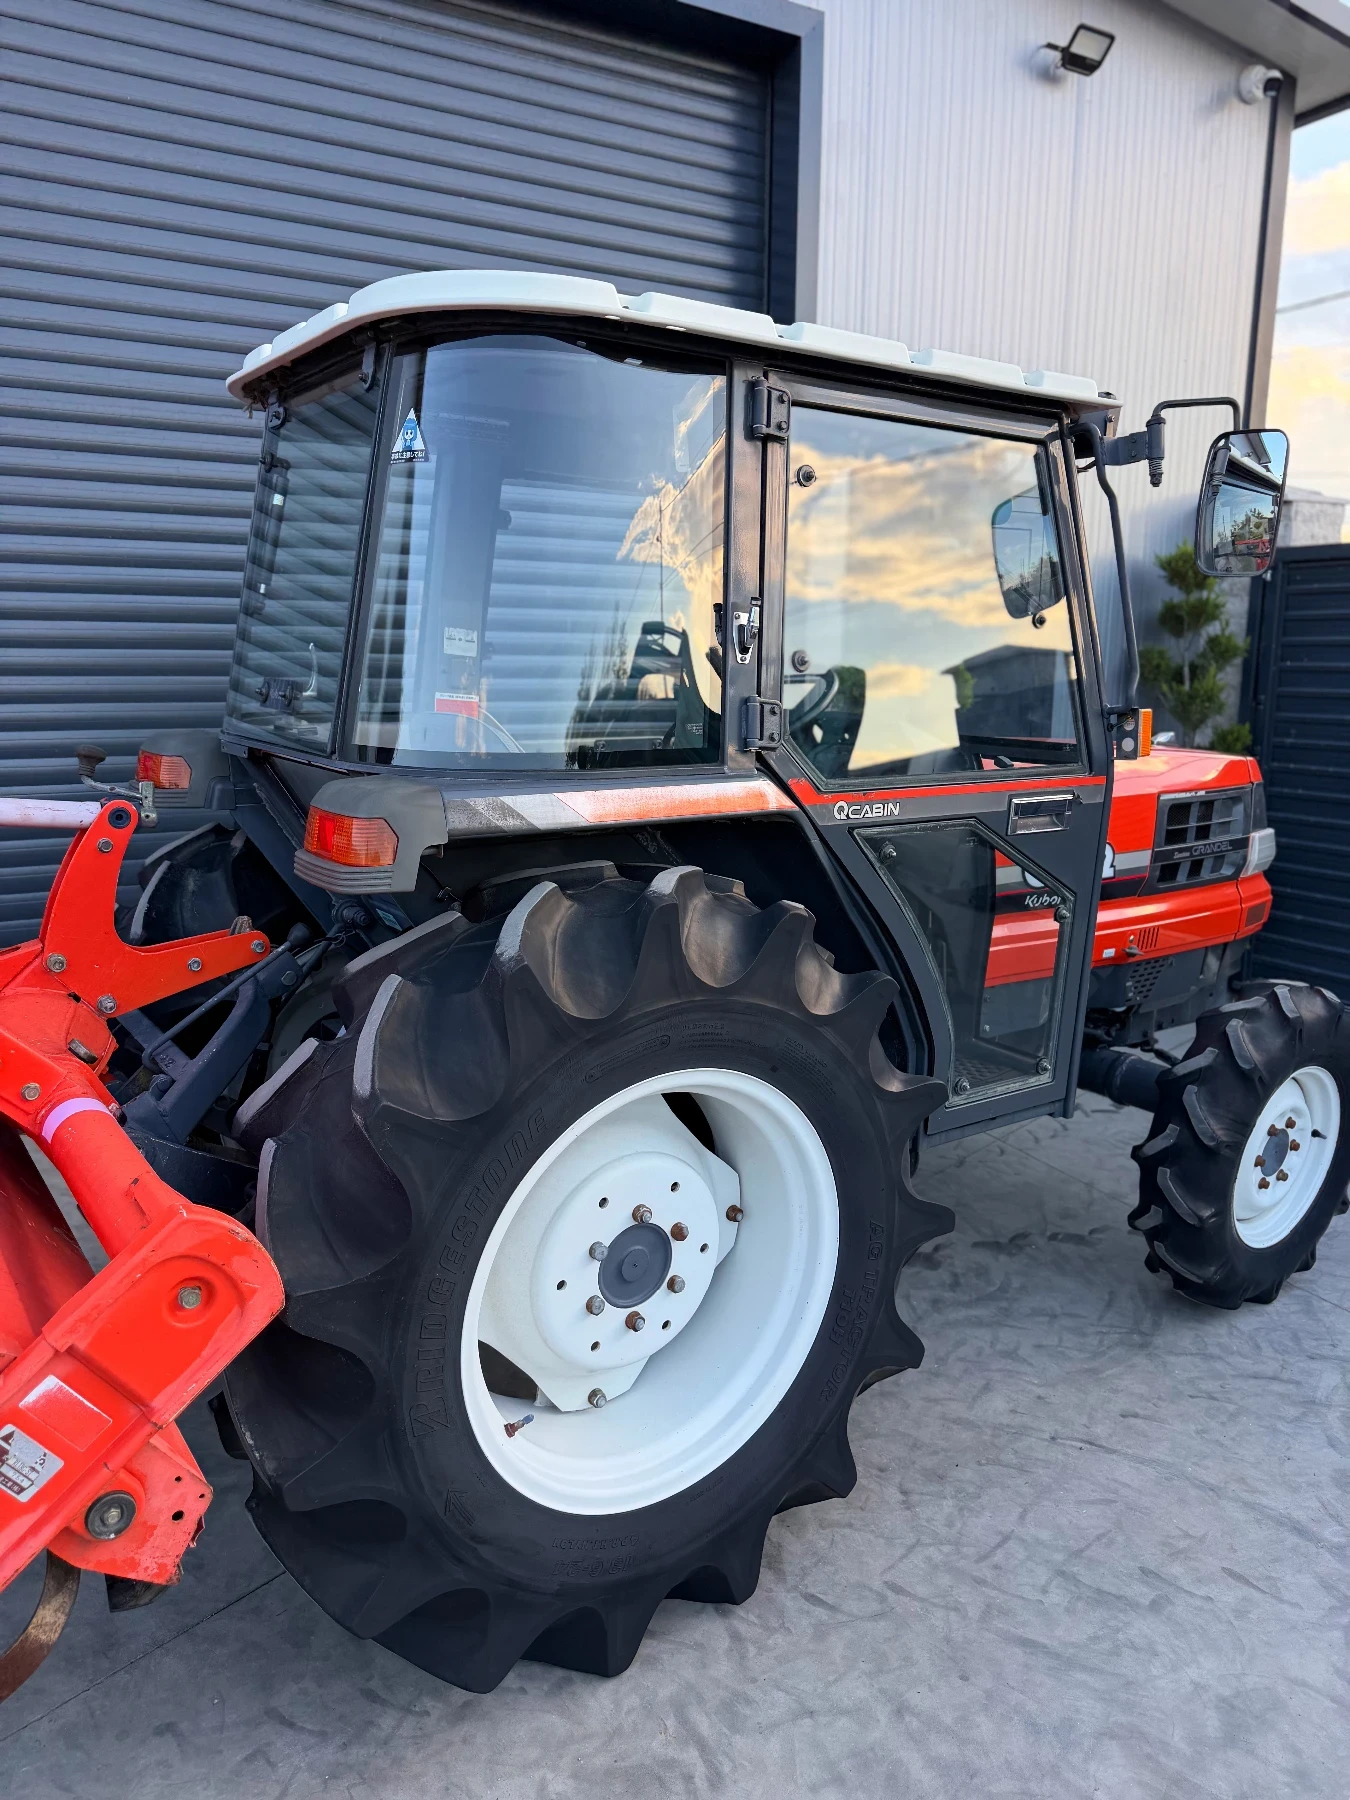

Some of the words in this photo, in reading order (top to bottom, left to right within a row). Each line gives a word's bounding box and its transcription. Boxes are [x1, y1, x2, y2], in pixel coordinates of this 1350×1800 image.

[1192, 841, 1232, 856] GRANDEL
[405, 1107, 548, 1438] BRIDGESTONE
[868, 1219, 885, 1261] AG
[820, 1268, 881, 1402] TRACTOR
